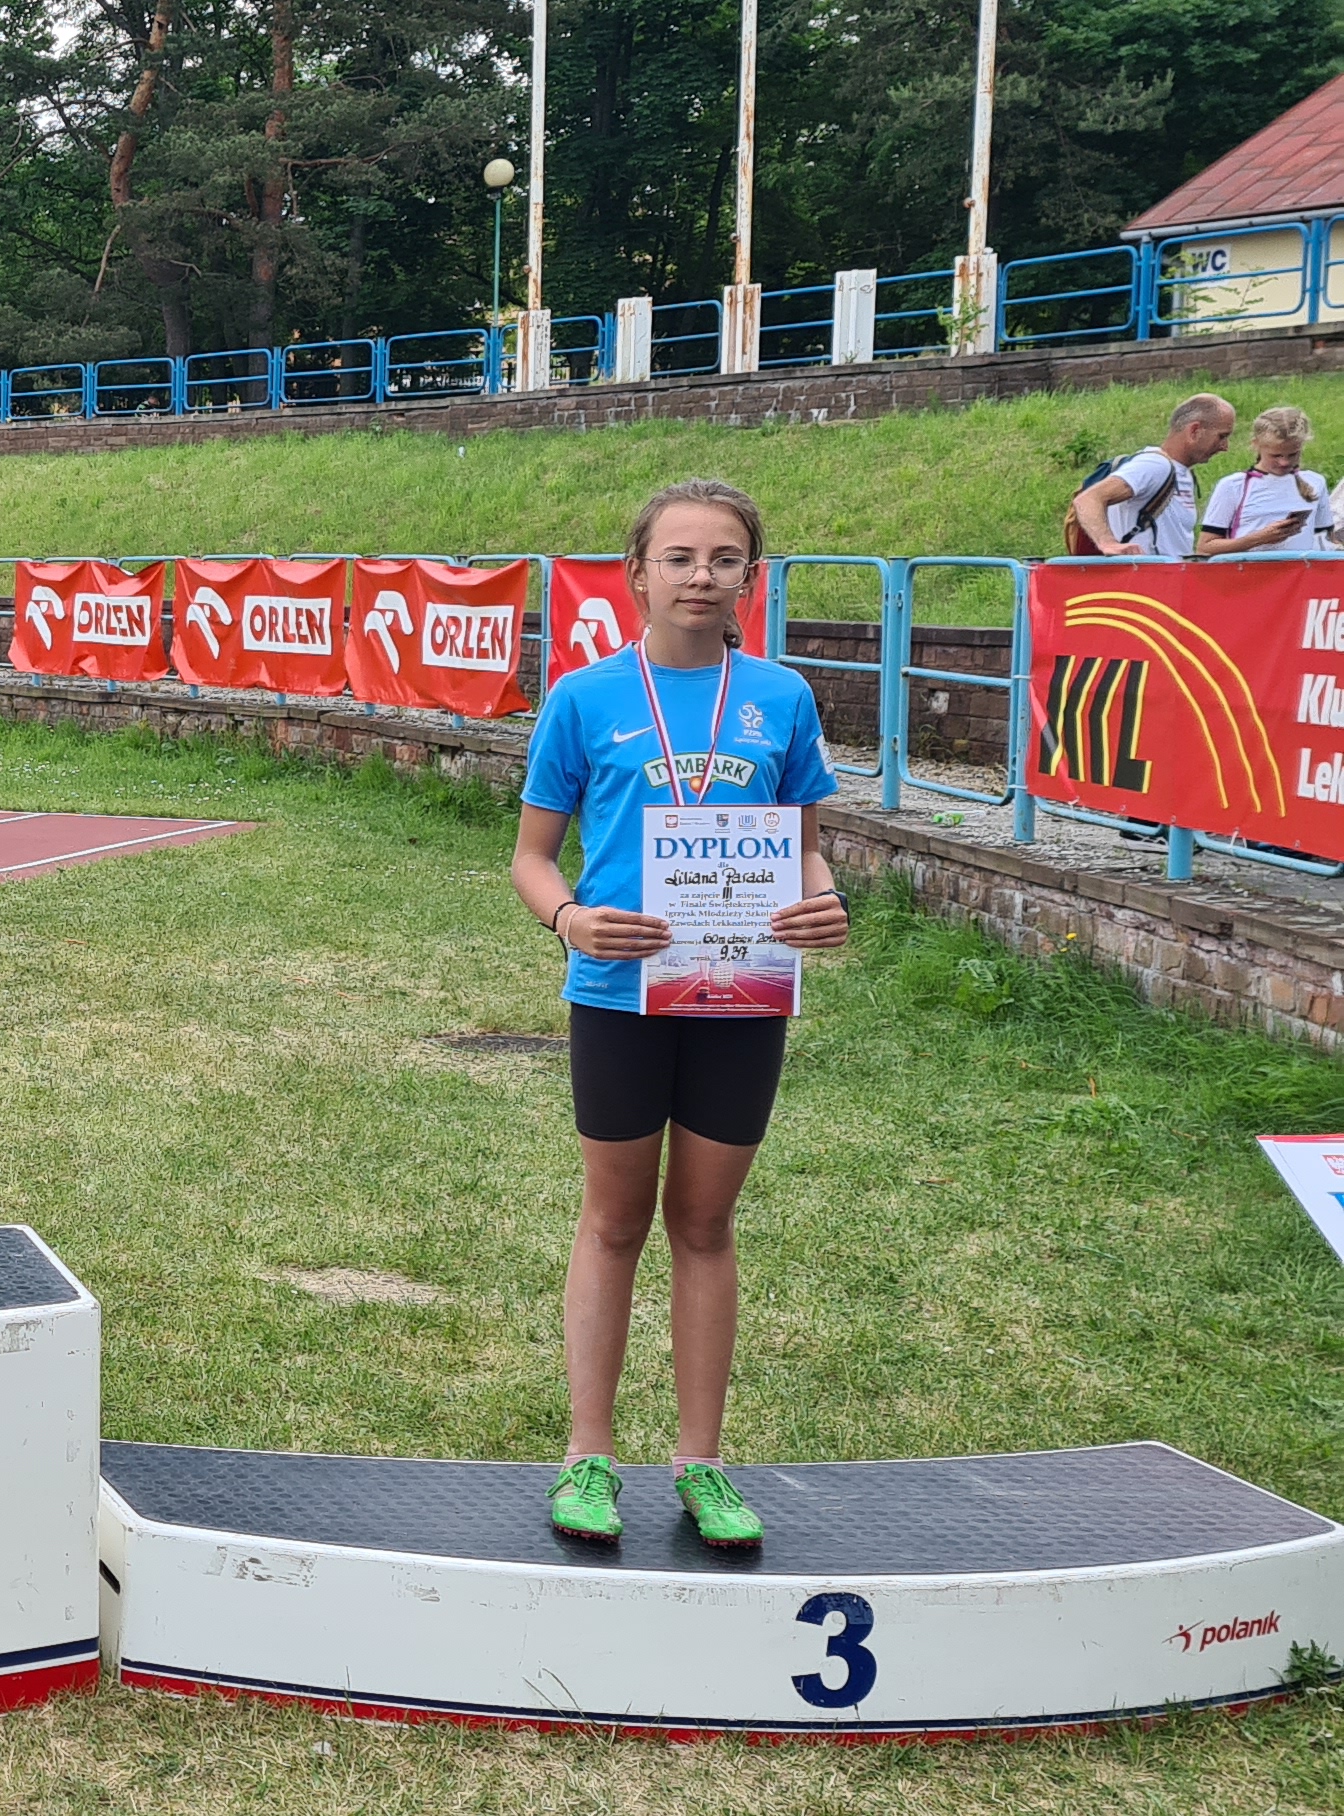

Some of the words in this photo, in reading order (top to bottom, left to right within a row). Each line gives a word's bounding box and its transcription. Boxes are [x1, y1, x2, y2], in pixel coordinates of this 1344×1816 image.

[1191, 249, 1227, 273] WC
[77, 600, 146, 637] ORLEN
[249, 604, 326, 645] ORLEN
[430, 614, 509, 661] ORLEN
[653, 837, 793, 859] DYPLOM
[712, 919, 772, 928] Lekkoatletyczn
[720, 944, 749, 962] 9,37
[1199, 1609, 1282, 1652] polanik
[791, 1592, 878, 1709] 3
